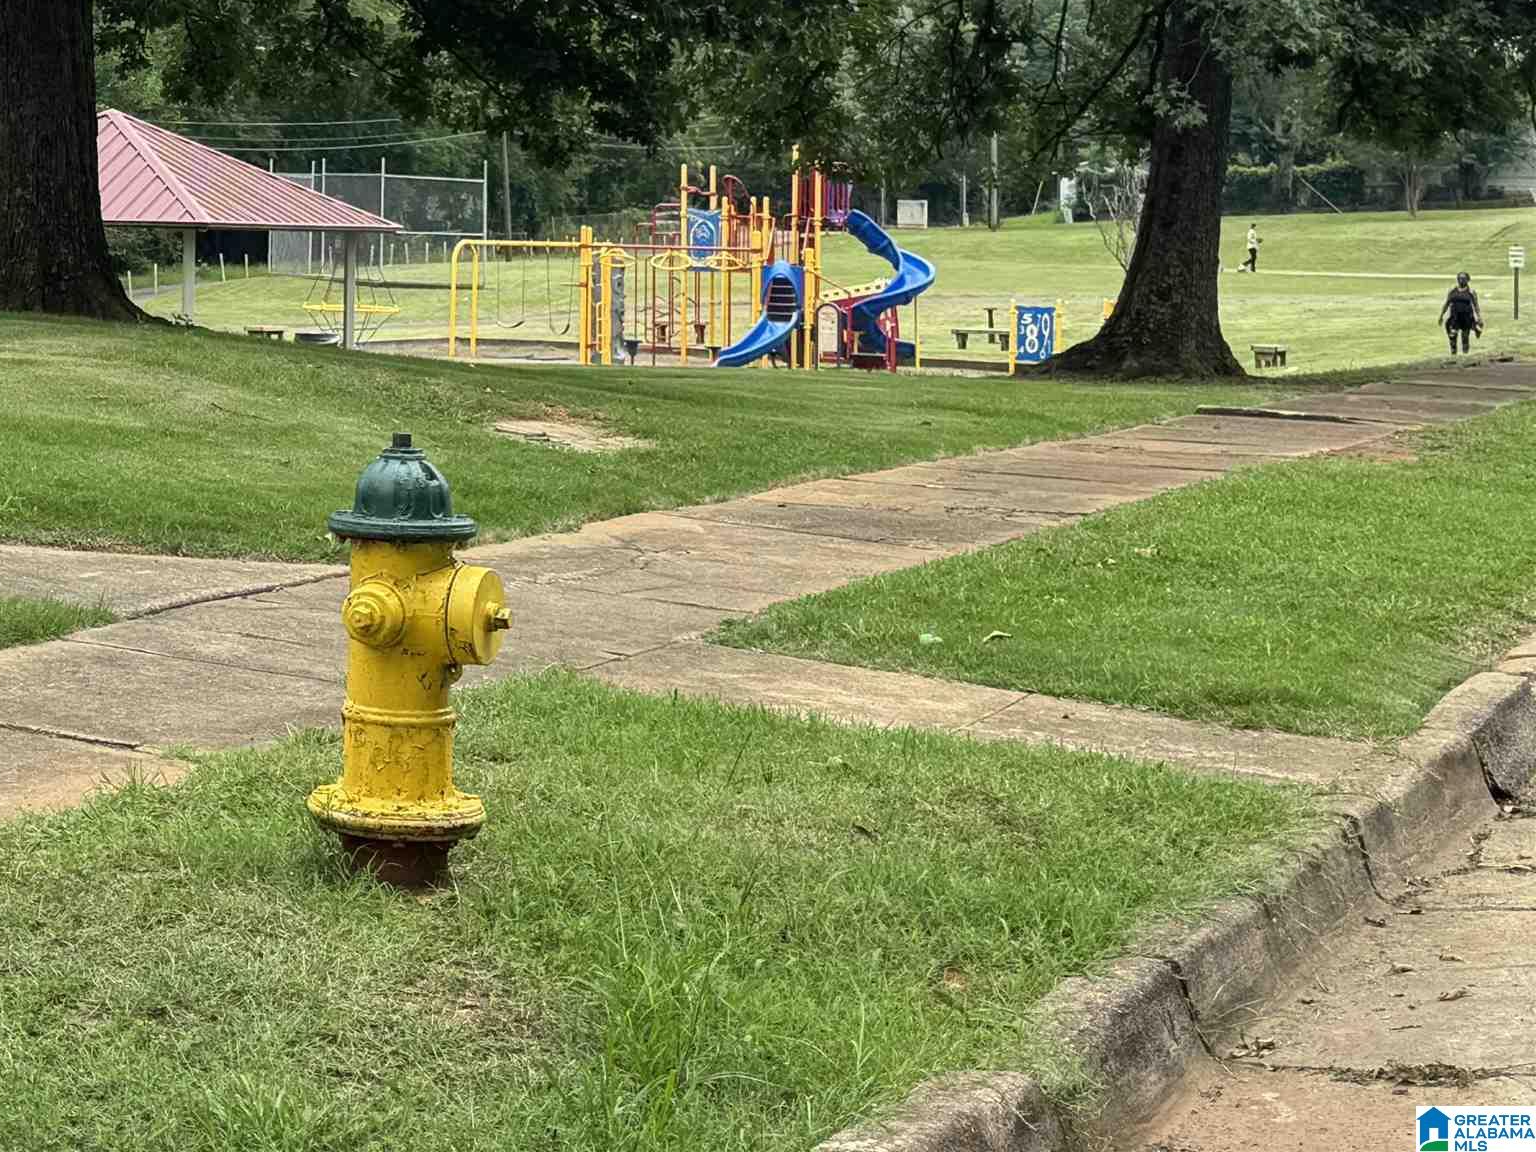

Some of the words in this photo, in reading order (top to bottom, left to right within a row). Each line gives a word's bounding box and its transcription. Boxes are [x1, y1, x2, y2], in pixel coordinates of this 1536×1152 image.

[1020, 313, 1033, 324] 5
[1041, 312, 1050, 346] 9
[1025, 324, 1039, 354] 8
